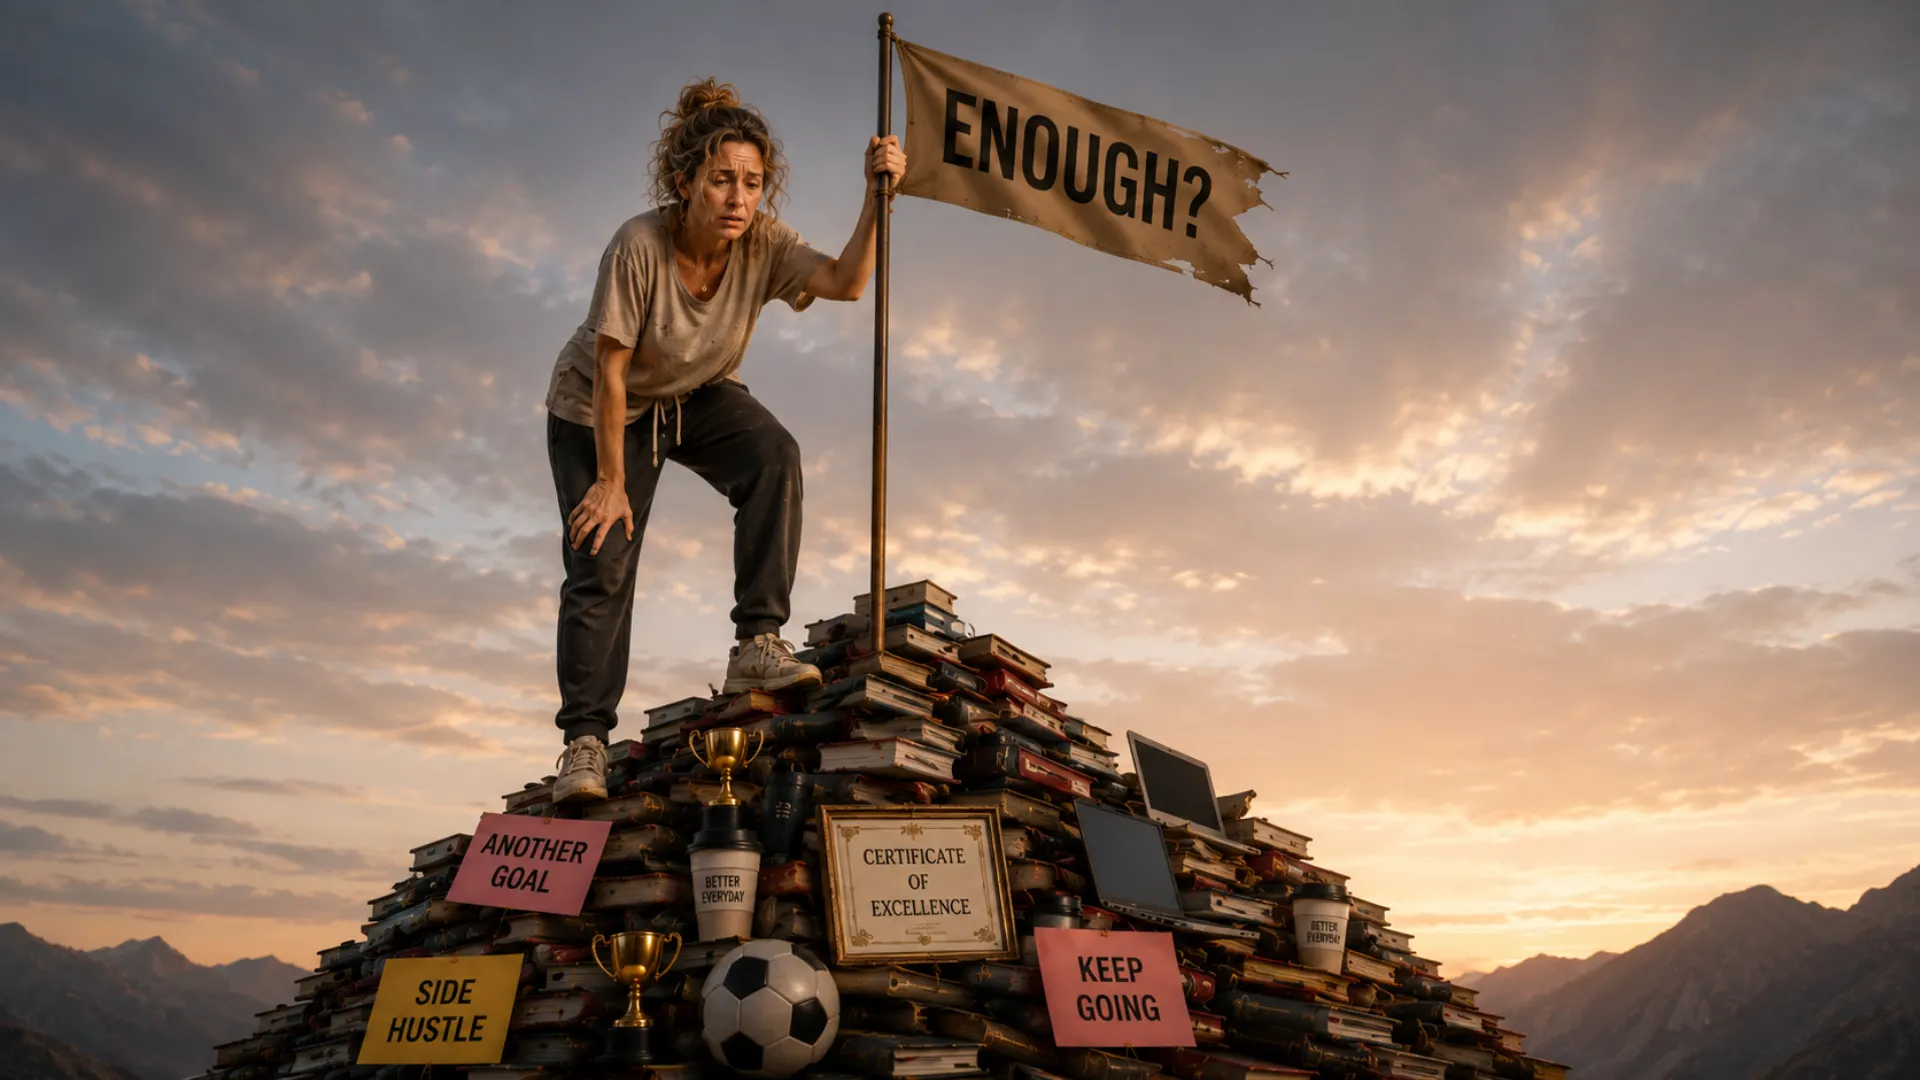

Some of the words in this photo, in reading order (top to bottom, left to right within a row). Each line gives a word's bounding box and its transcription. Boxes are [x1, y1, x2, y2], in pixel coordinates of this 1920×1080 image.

[942, 87, 1212, 239] ENOUGH?
[480, 833, 588, 864] ANOTHER
[863, 848, 966, 865] CERTIFICATE
[490, 865, 550, 893] GOAL
[705, 875, 740, 888] BETTER
[908, 873, 929, 890] OF
[702, 890, 744, 904] EVERYDAY
[871, 898, 971, 917] EXCELLENCE
[1077, 956, 1143, 983] KEEP
[415, 978, 476, 1005] SIDE
[1076, 994, 1161, 1022] GOING
[386, 1015, 487, 1043] HUSTLE
